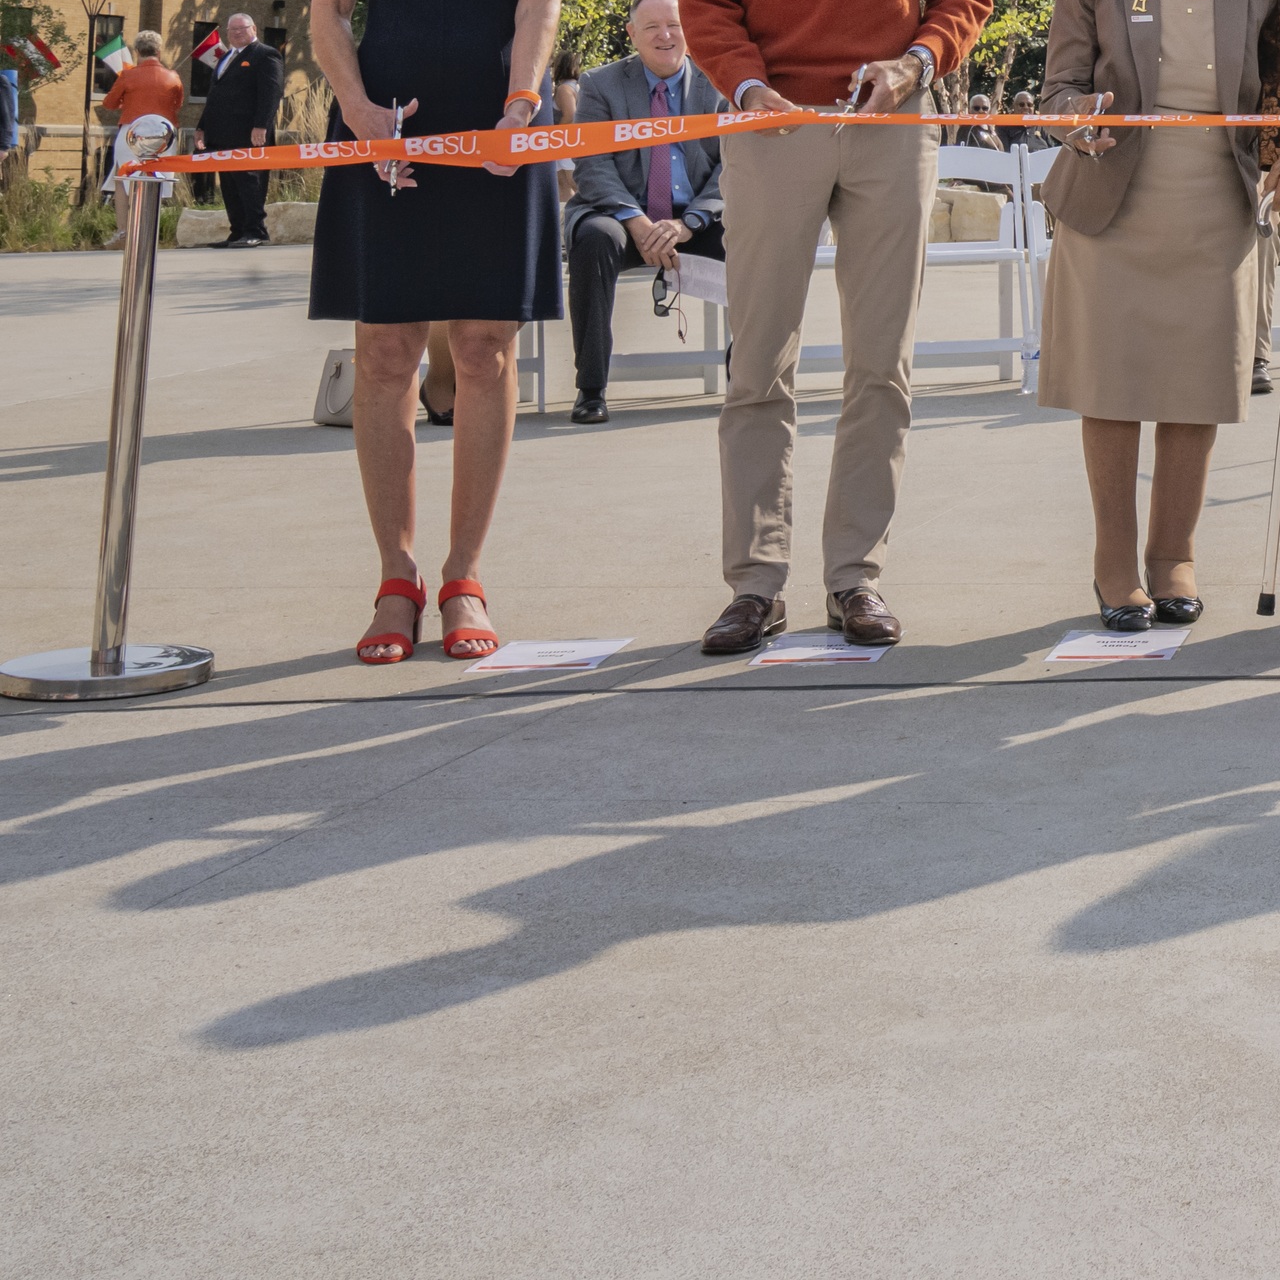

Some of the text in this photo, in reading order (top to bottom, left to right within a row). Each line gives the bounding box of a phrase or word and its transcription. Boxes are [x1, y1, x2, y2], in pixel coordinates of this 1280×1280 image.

[299, 140, 372, 159] BGSU
[405, 136, 477, 155] BGSU
[511, 128, 581, 152] BGSU
[614, 119, 684, 142] BGSU
[717, 111, 788, 127] BGSU
